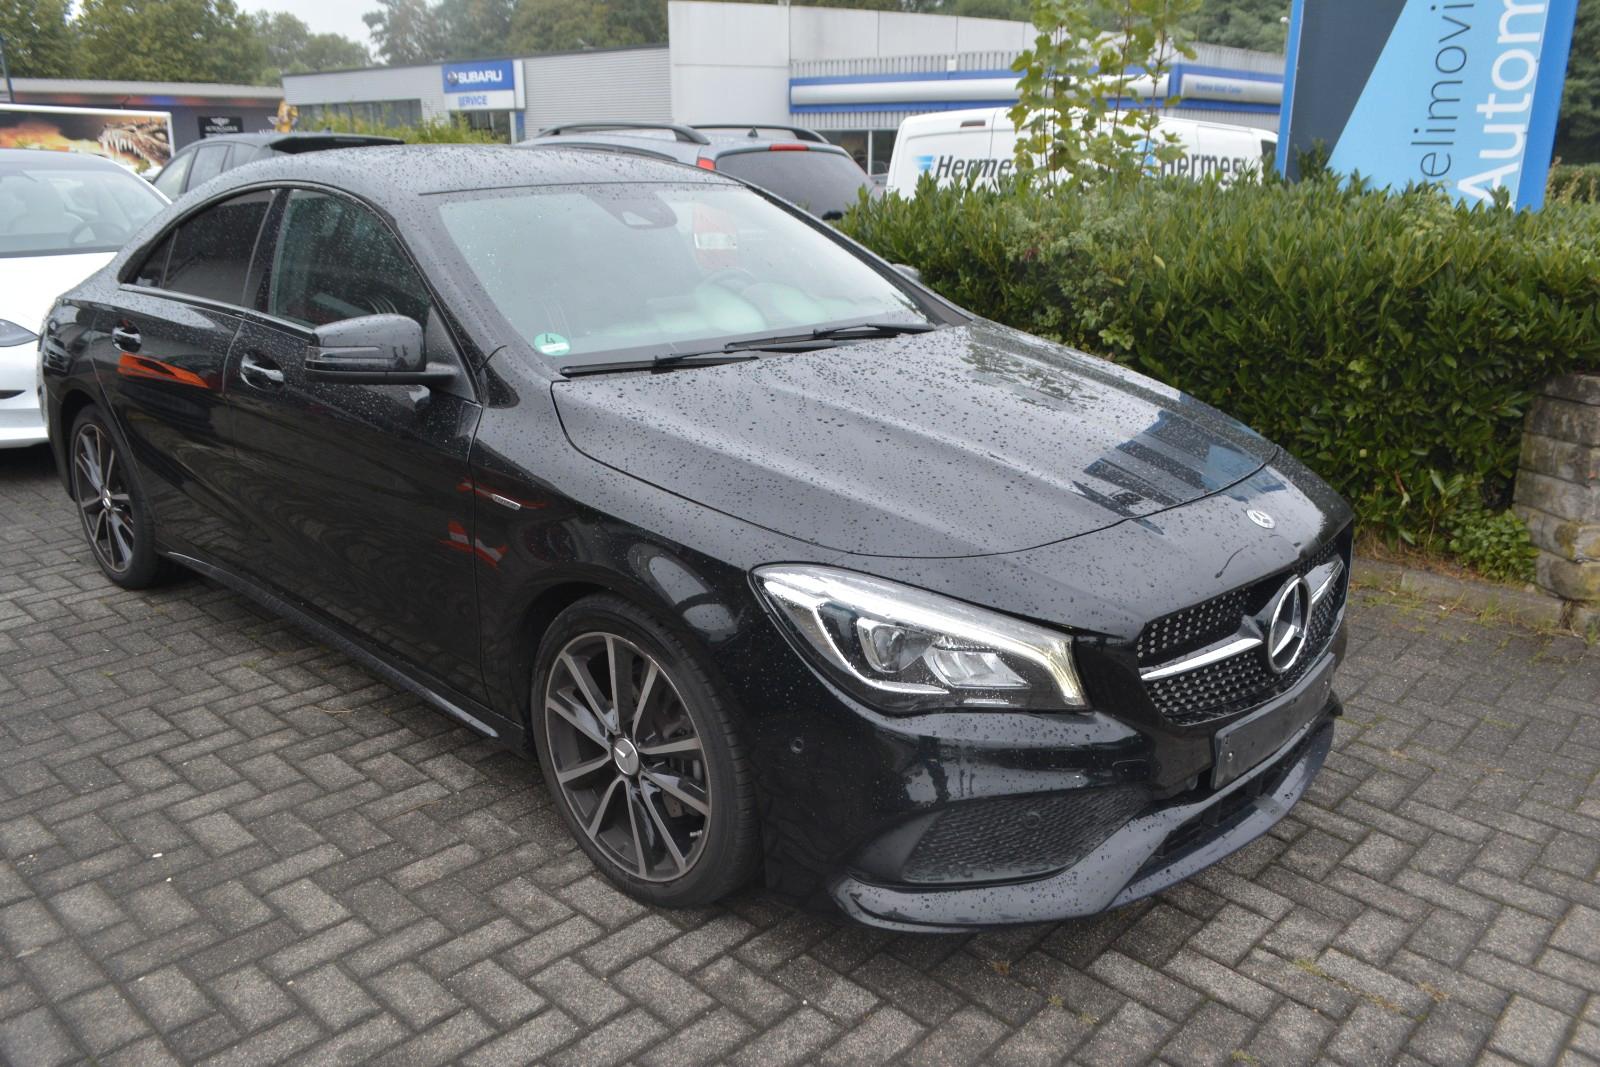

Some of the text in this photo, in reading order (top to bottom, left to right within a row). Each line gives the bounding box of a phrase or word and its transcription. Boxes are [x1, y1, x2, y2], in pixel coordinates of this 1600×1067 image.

[458, 69, 503, 84] SUBARU
[457, 95, 488, 107] SERVICE
[1411, 2, 1475, 190] elimovi
[936, 154, 1013, 178] Herme
